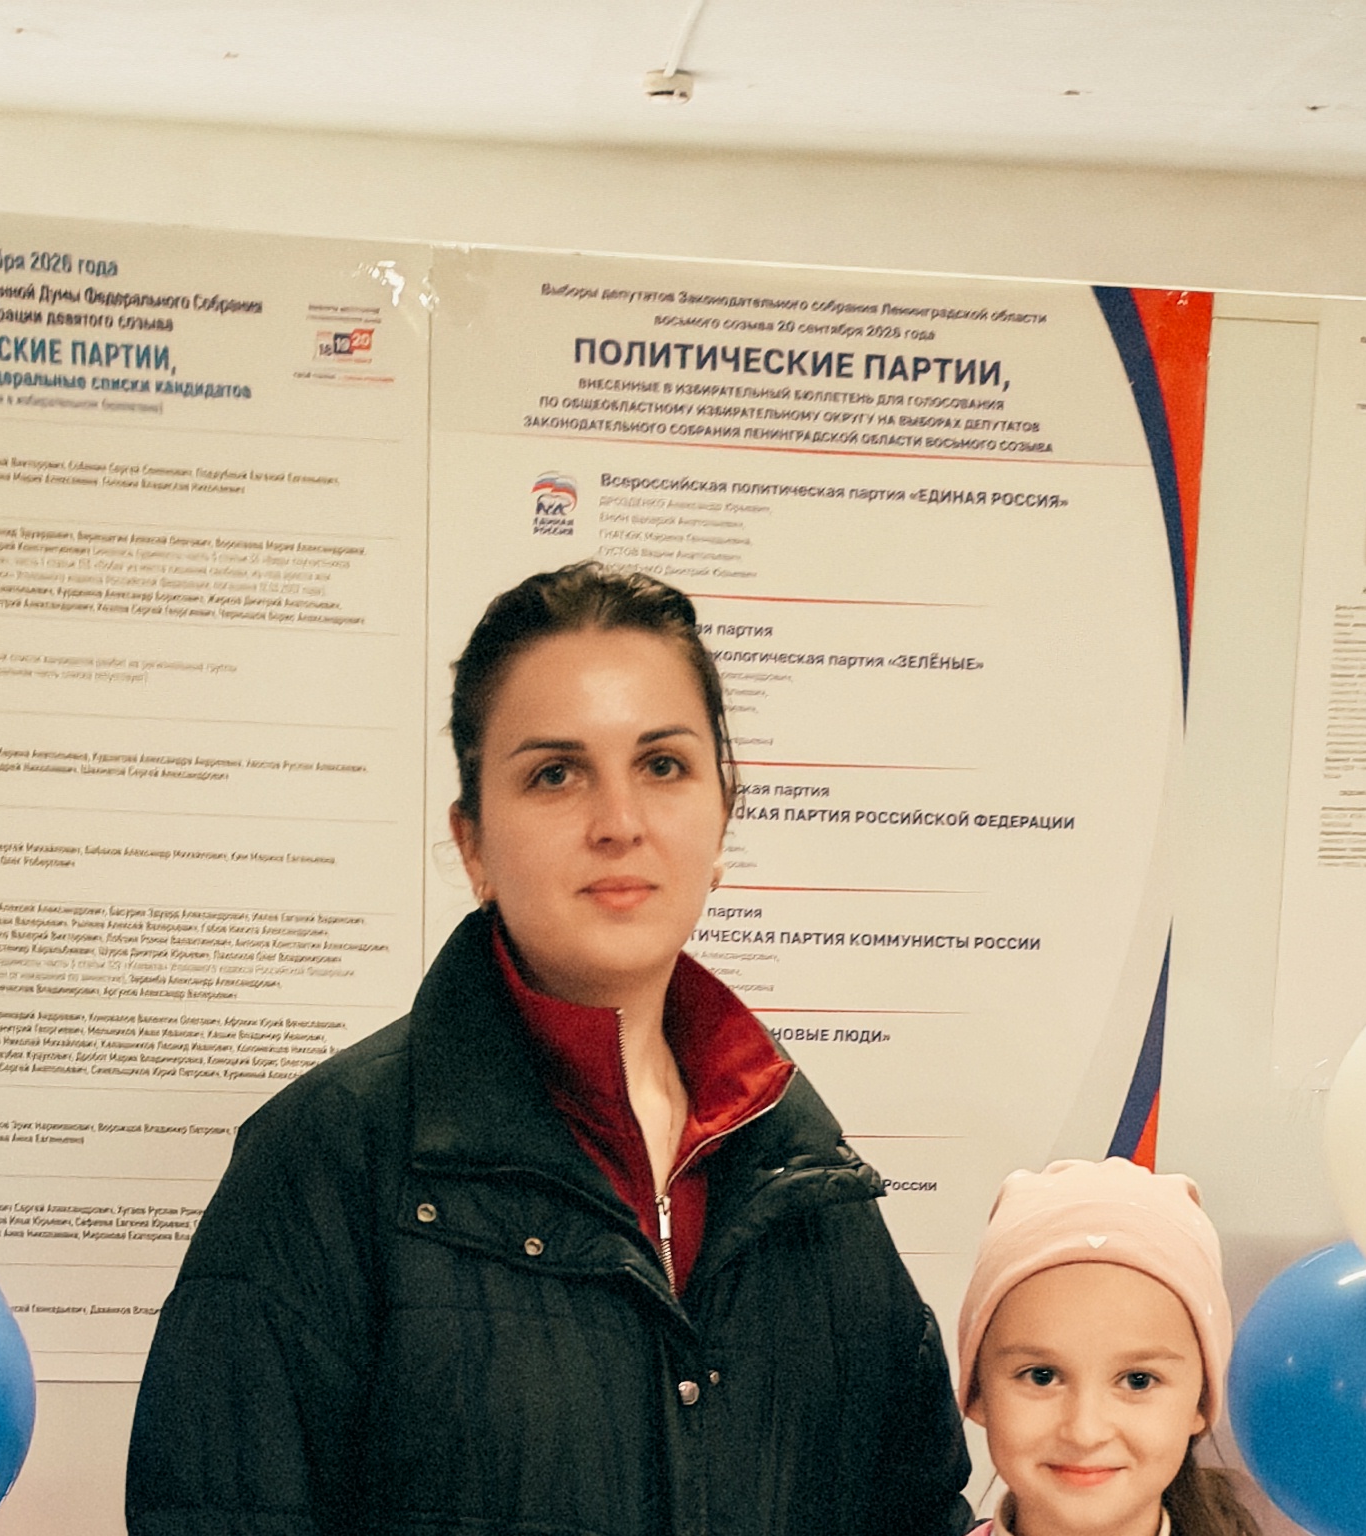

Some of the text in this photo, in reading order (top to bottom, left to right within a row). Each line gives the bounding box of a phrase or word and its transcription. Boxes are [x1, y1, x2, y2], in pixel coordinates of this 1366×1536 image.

[30, 251, 72, 273] 2026
[78, 258, 118, 278] года
[39, 284, 81, 306] Думы
[84, 287, 190, 309] Федерального
[193, 294, 263, 314] Собрания
[46, 312, 113, 328] девятого
[118, 315, 173, 332] созыва
[71, 340, 175, 374] ПАРТИИ,
[575, 338, 1008, 387] ПОЛИТИЧЕСКИЕ ПАРТИИ,
[91, 377, 150, 393] списки
[155, 380, 251, 399] кандидатов
[578, 377, 1004, 411] ВНЕСЕННЫЕ В ИЗБИРАТЕЛЬНЫЙ БЮЛЛЕТЕНЬ ДЛЯ ГОЛОСОВАНИЯ
[539, 395, 1040, 433] ПО ОБЩЕОБЛАСТНОМУ ИЗБИРАТЕЛЬНОМУ ОКРУГУ НА ВЫБОРАХ ДЕПУТАТОВ
[524, 416, 1053, 453] ЗАКОНОДАТЕЛЬНОГО СОБРАНИЯ ЛЕНИНГРАДСКОЙ ОБЛАСТИ ВОСЬМОГО СОЗЫВА
[600, 473, 1068, 508] Всероссийская политическая партия «ЕДИНАЯ РОССИЯ»
[717, 624, 773, 639] партия
[715, 651, 983, 670] кологическая партия «ЗЕЛЁНЫЕ»
[774, 785, 830, 800] партия
[784, 808, 1075, 830] ПАРТИЯ РОССИЙСКОЙ ФЕДЕРАЦИИ
[707, 907, 762, 920] партия
[780, 931, 845, 946] ПАРТИЯ
[849, 933, 970, 949] КОММУНИСТЫ
[974, 936, 1041, 951] РОССИИ
[834, 1029, 891, 1045] ЛЮДИ»
[882, 1178, 938, 1193] России
